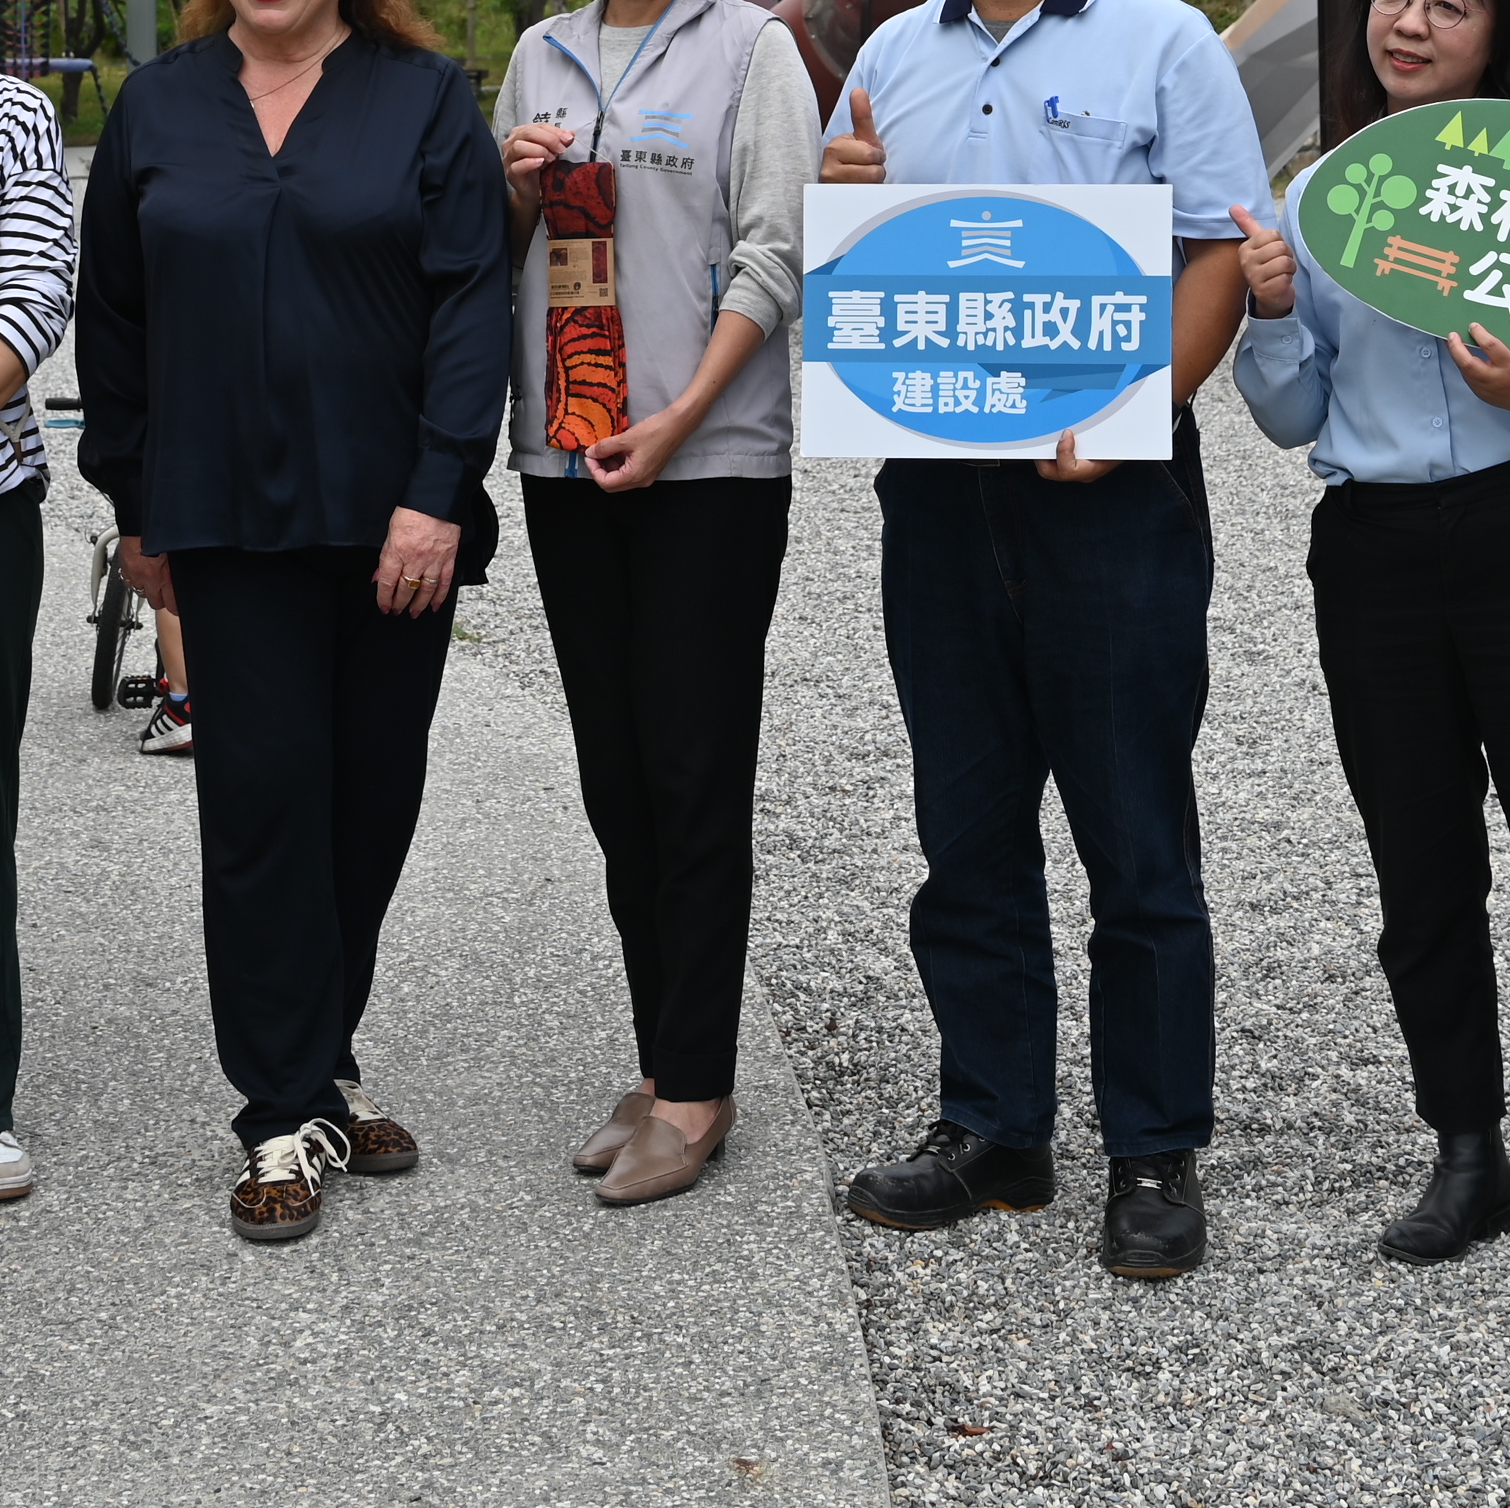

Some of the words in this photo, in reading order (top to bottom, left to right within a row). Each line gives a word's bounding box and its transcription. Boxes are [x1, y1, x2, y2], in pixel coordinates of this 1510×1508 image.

[620, 149, 695, 170] 臺東縣政府
[826, 290, 1148, 352] 臺東縣政府
[891, 370, 1028, 416] 建設處
